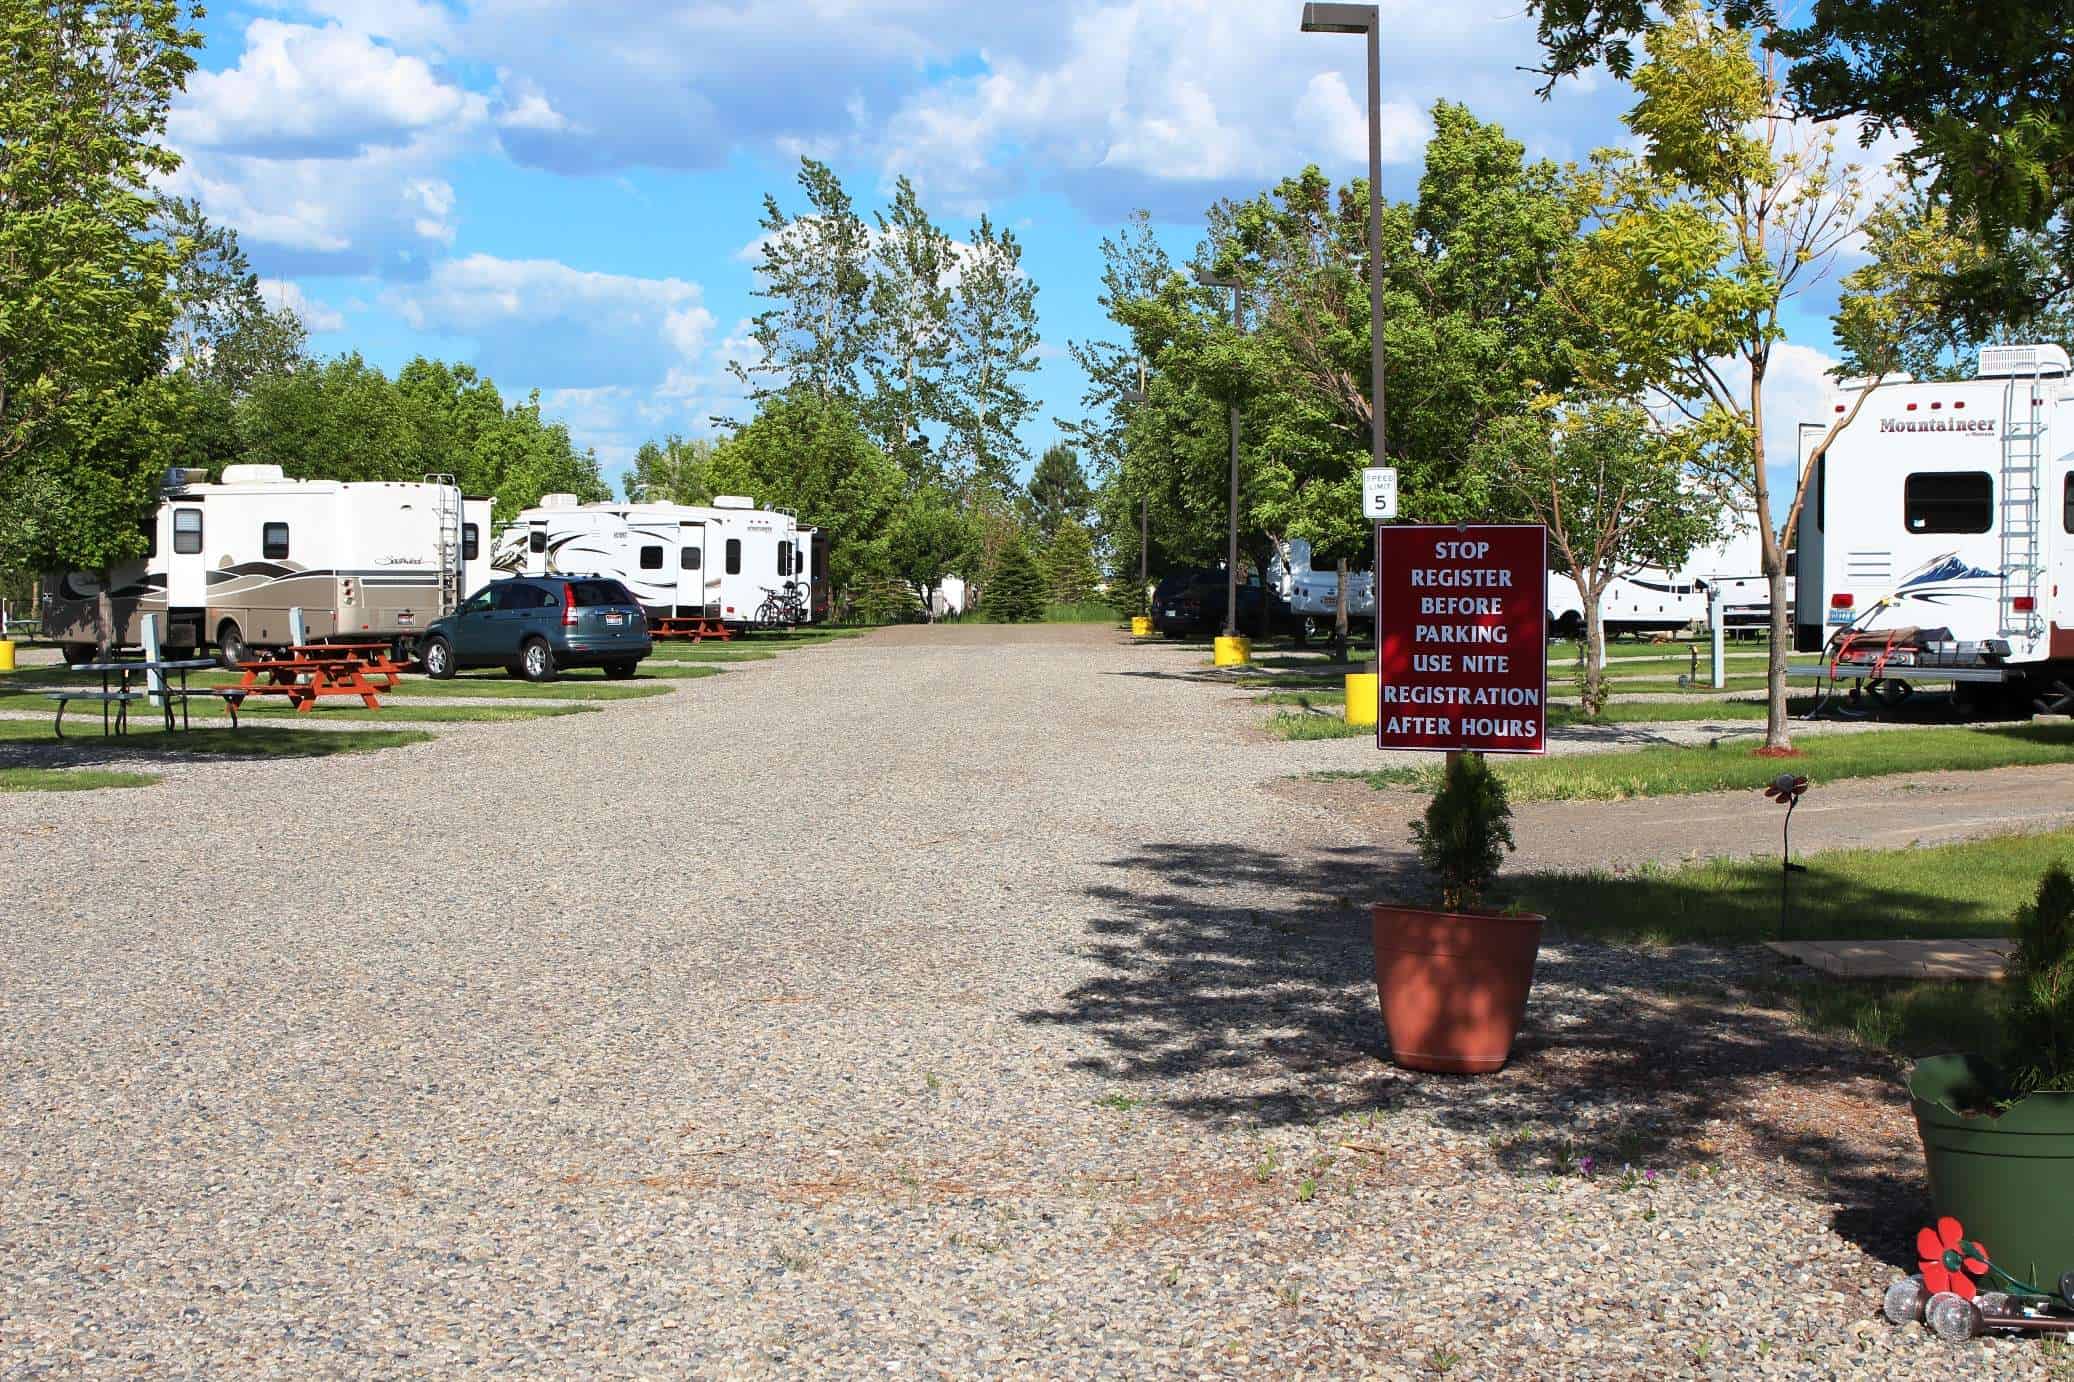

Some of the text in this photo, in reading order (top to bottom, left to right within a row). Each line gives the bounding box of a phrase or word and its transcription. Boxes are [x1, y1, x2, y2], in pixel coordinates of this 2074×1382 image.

[1880, 417, 1995, 433] Mountaineer
[1366, 474, 1394, 482] SPEED
[1369, 482, 1391, 490] LIMIT
[1375, 495, 1387, 510] 5
[1435, 541, 1489, 560] STOP
[1411, 569, 1513, 587] REGISTER
[1421, 597, 1503, 615] BEFORE
[1415, 625, 1508, 643] PARKING
[1413, 655, 1510, 673] USE NITE
[1384, 685, 1539, 706] REGISTRATION
[1386, 716, 1537, 738] AFTER HOURS
